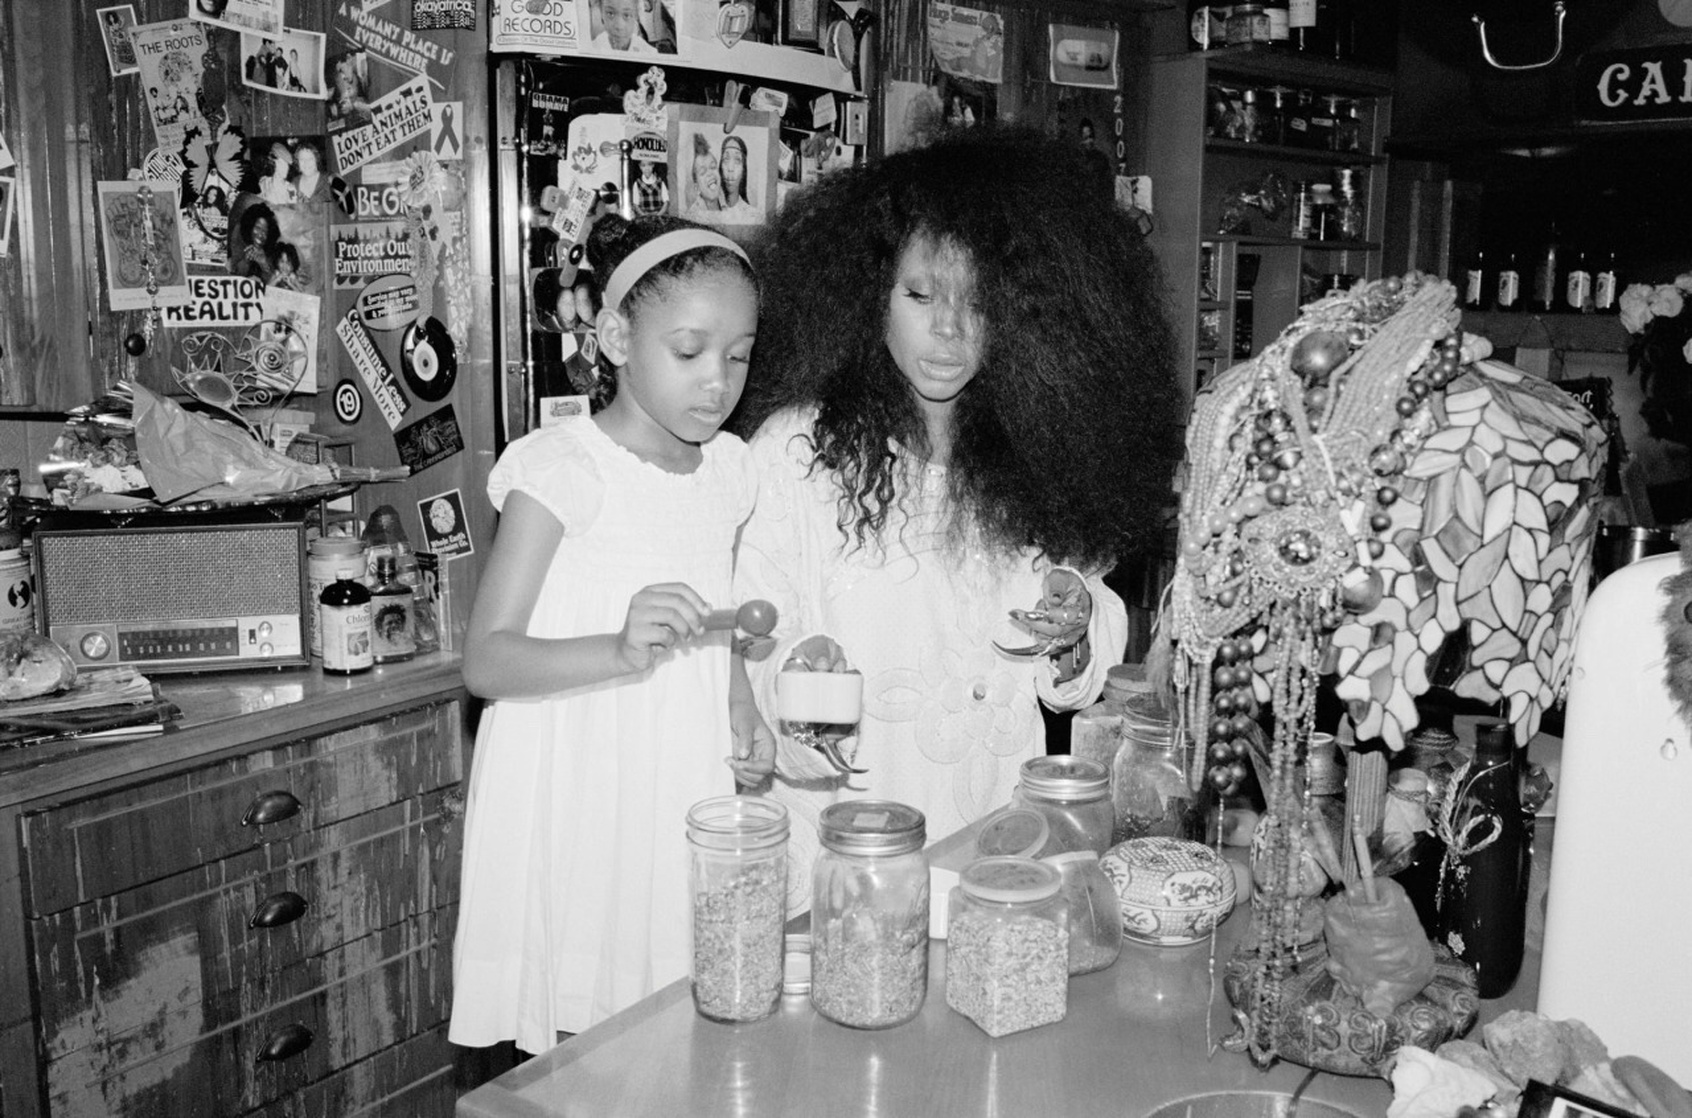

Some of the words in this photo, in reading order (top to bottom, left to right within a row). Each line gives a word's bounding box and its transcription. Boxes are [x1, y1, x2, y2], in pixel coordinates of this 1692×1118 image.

[338, 2, 347, 16] A
[402, 30, 438, 60] PLACE
[440, 48, 453, 65] IS
[504, 18, 572, 36] RECORDS
[140, 42, 162, 55] THE
[165, 35, 202, 51] ROOTS
[354, 26, 428, 72] EVERYWHERE
[534, 92, 568, 104] OBAMA
[337, 128, 369, 154] LOVE
[372, 95, 428, 136] ANIMALS
[340, 142, 373, 170] DON'T
[376, 129, 398, 151] EAT
[399, 109, 433, 137] THEM
[358, 187, 380, 216] BE
[338, 242, 385, 257] Protect
[336, 256, 412, 274] Environmen
[188, 279, 266, 299] ESTION
[340, 324, 371, 376] Share
[372, 378, 396, 420] More
[348, 308, 387, 378] Consume
[384, 372, 406, 412] Less
